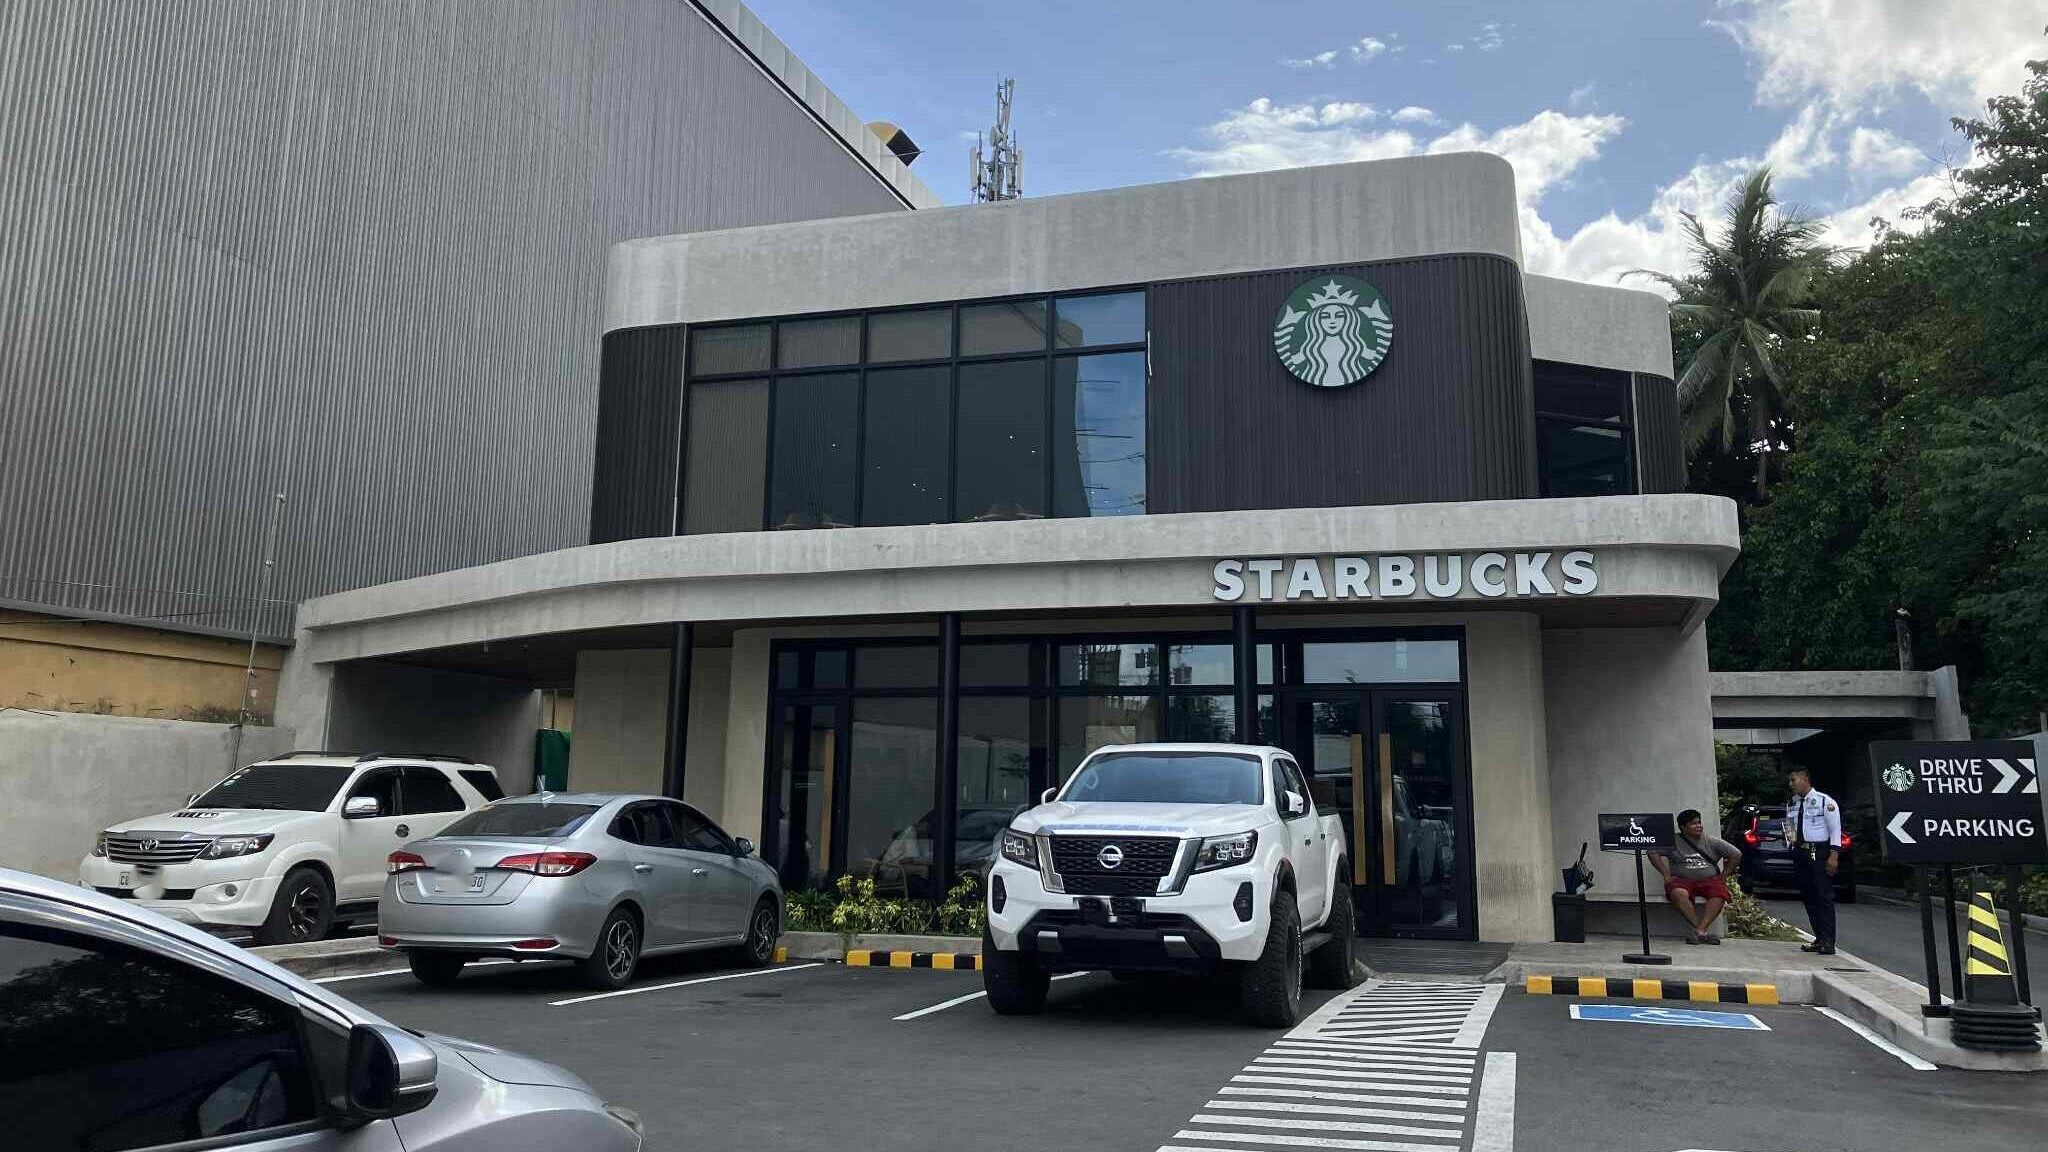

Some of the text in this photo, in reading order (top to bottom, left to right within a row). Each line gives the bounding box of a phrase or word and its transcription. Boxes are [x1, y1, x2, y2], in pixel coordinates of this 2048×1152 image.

[1213, 551, 1599, 601] STARBUCKS
[1919, 758, 1984, 776] DRIVE
[1921, 777, 1984, 795] THRU
[1923, 818, 2035, 838] PARKING
[1620, 836, 1656, 844] PARKING
